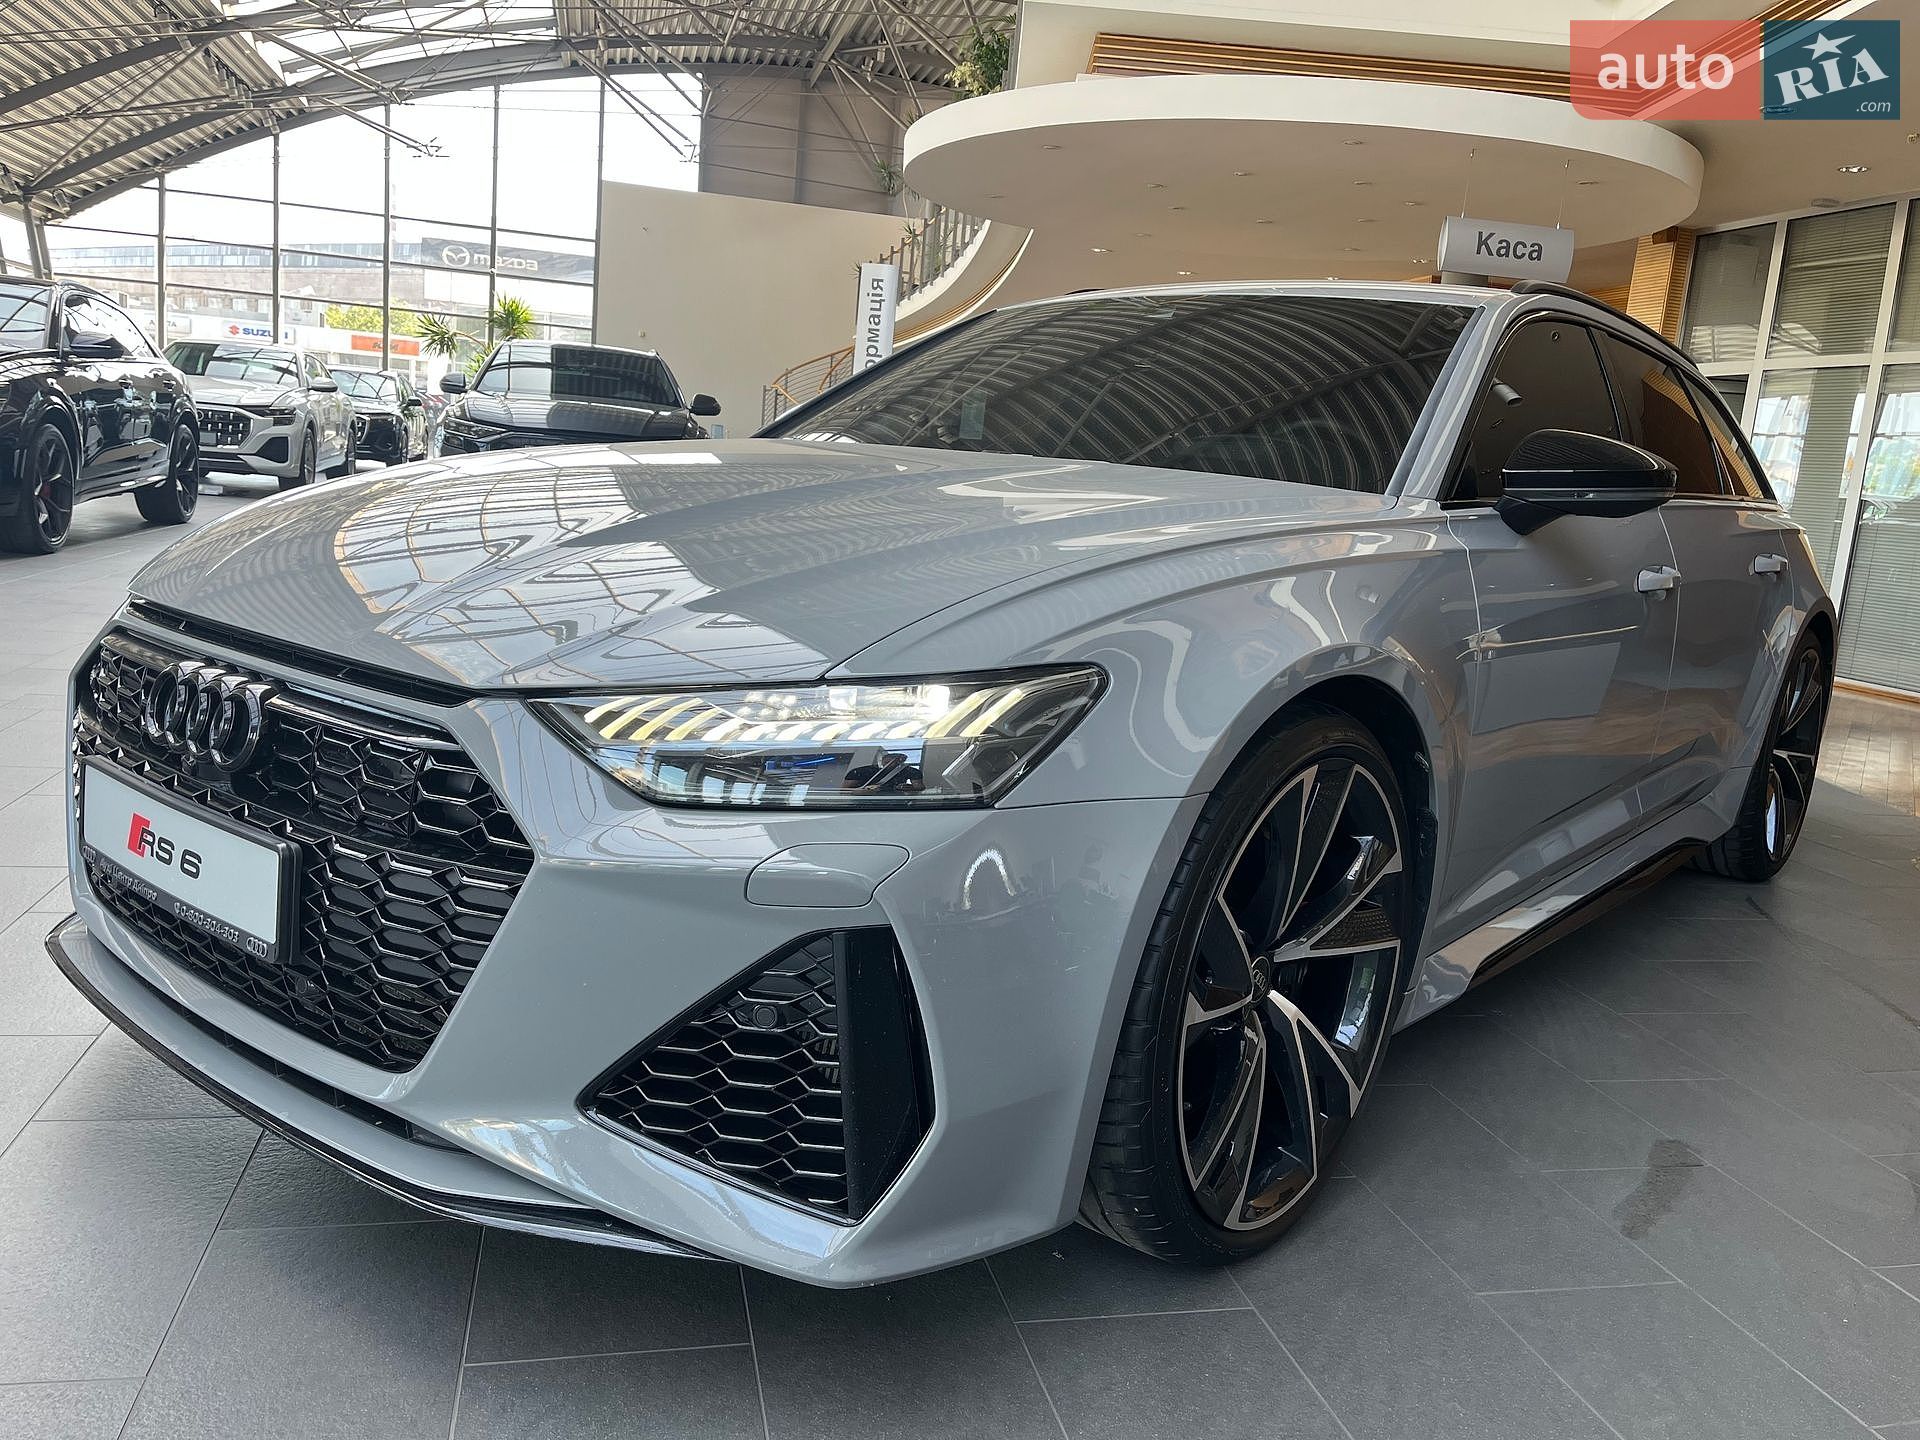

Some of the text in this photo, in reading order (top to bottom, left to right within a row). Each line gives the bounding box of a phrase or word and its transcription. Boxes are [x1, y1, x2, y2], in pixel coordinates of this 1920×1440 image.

[1476, 231, 1543, 262] Каса
[242, 327, 289, 340] SUZUI
[865, 278, 885, 369] ормація
[137, 826, 202, 879] RS 6
